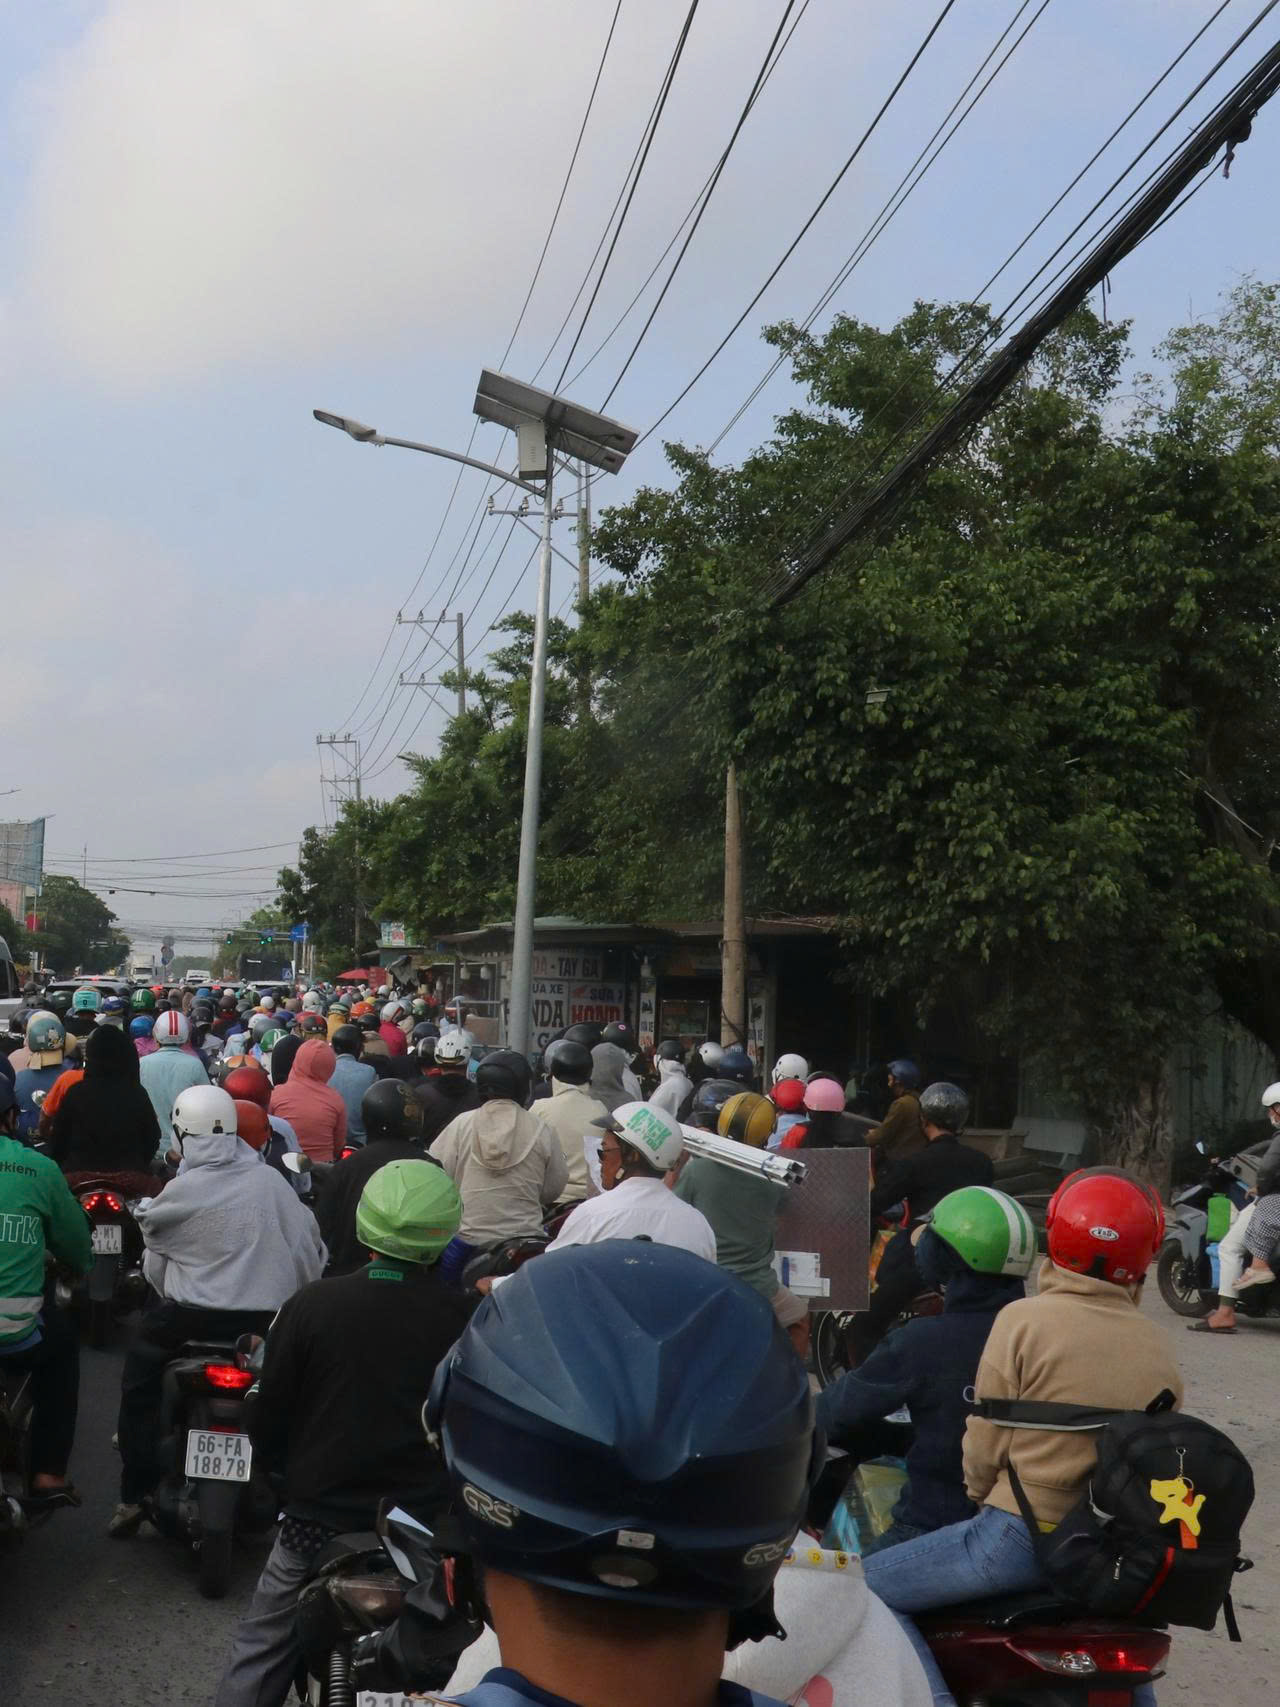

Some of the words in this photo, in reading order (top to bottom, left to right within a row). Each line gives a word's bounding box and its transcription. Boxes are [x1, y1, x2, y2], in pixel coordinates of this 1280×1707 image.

[558, 957, 578, 977] TAY
[581, 958, 599, 978] GA
[532, 983, 546, 994] UA
[549, 983, 564, 995] XE
[571, 1004, 621, 1025] HOND
[197, 1434, 242, 1457] 66-FA
[192, 1454, 246, 1478] 188.78
[462, 1482, 514, 1529] GRS
[743, 1539, 790, 1568] GRS
